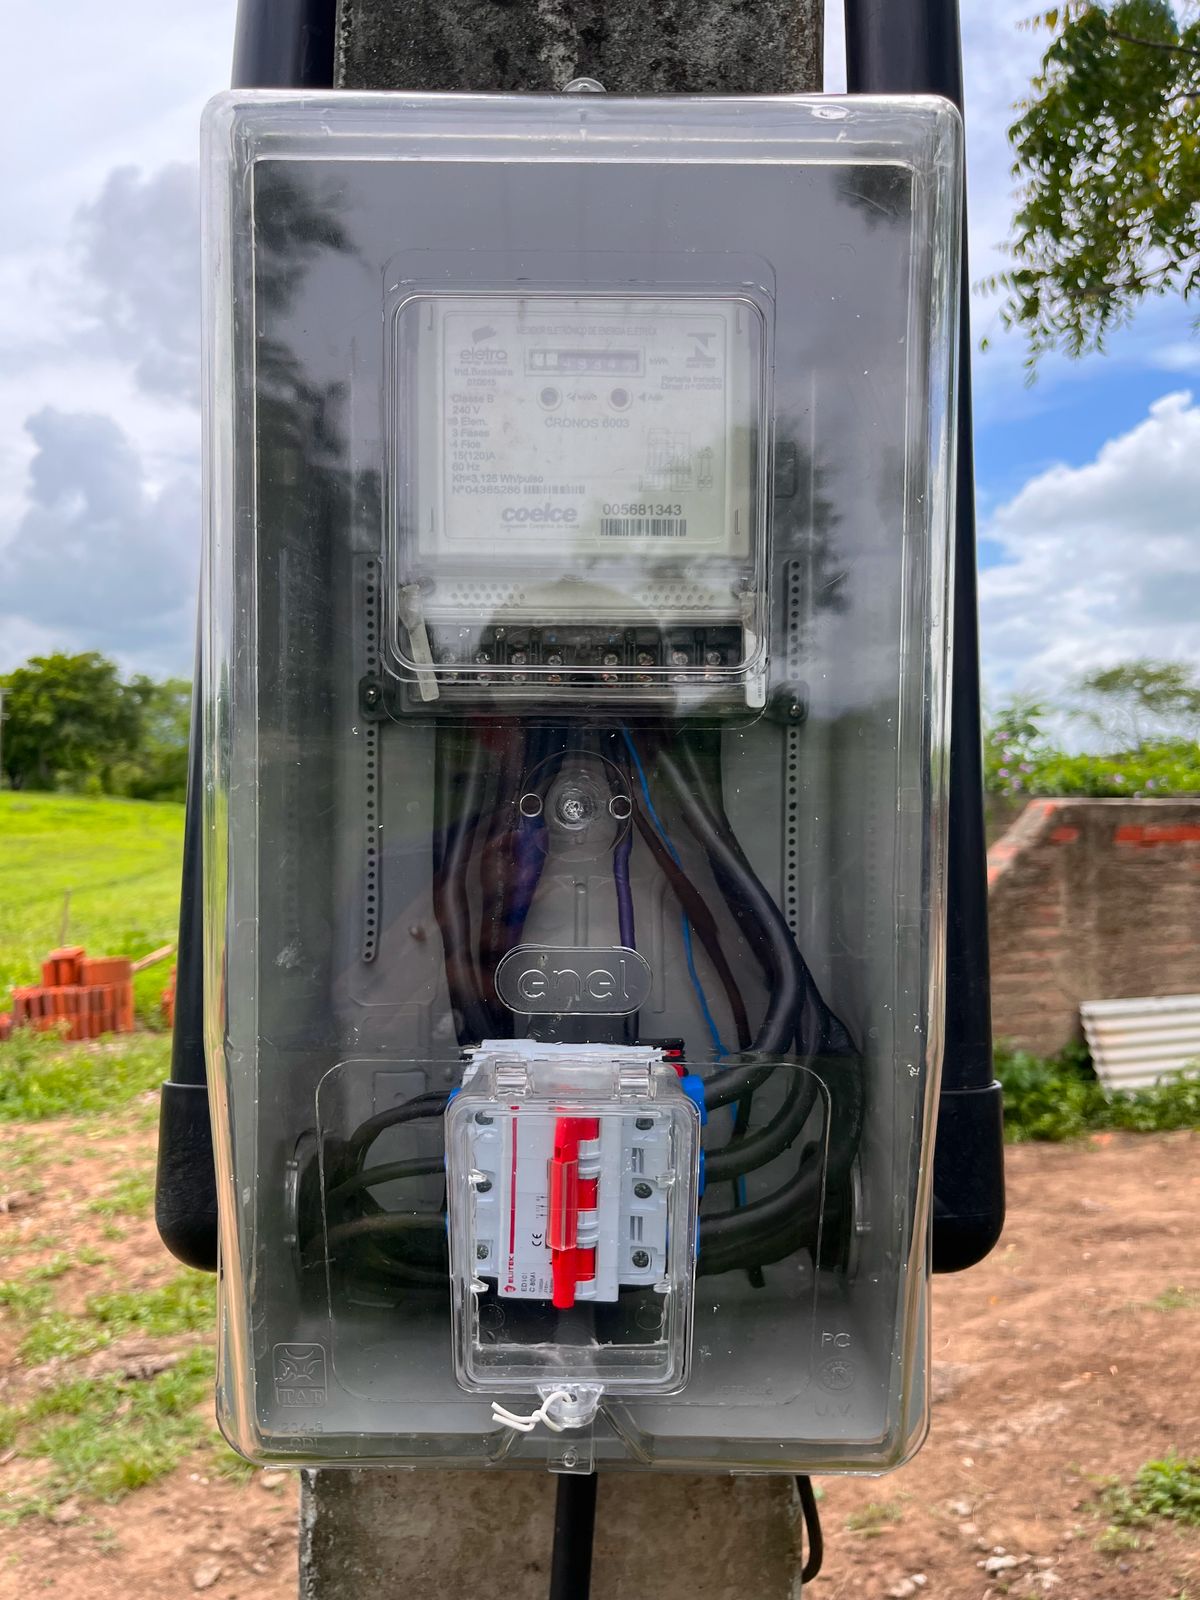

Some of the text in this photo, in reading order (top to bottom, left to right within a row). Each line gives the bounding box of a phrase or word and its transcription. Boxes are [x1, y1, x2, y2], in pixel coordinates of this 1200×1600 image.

[460, 347, 508, 361] eletra
[452, 405, 481, 415] 240 V
[544, 417, 630, 429] CRONOS 6003
[452, 428, 490, 438] 3 Fases
[460, 440, 481, 449] Fios
[453, 451, 496, 462] 15(120)A
[452, 462, 480, 472] 60 Hz
[502, 502, 577, 522] coelce
[602, 503, 682, 516] 005681343
[517, 959, 629, 1002] enel
[532, 1233, 542, 1247] CE
[821, 1330, 851, 1347] PC
